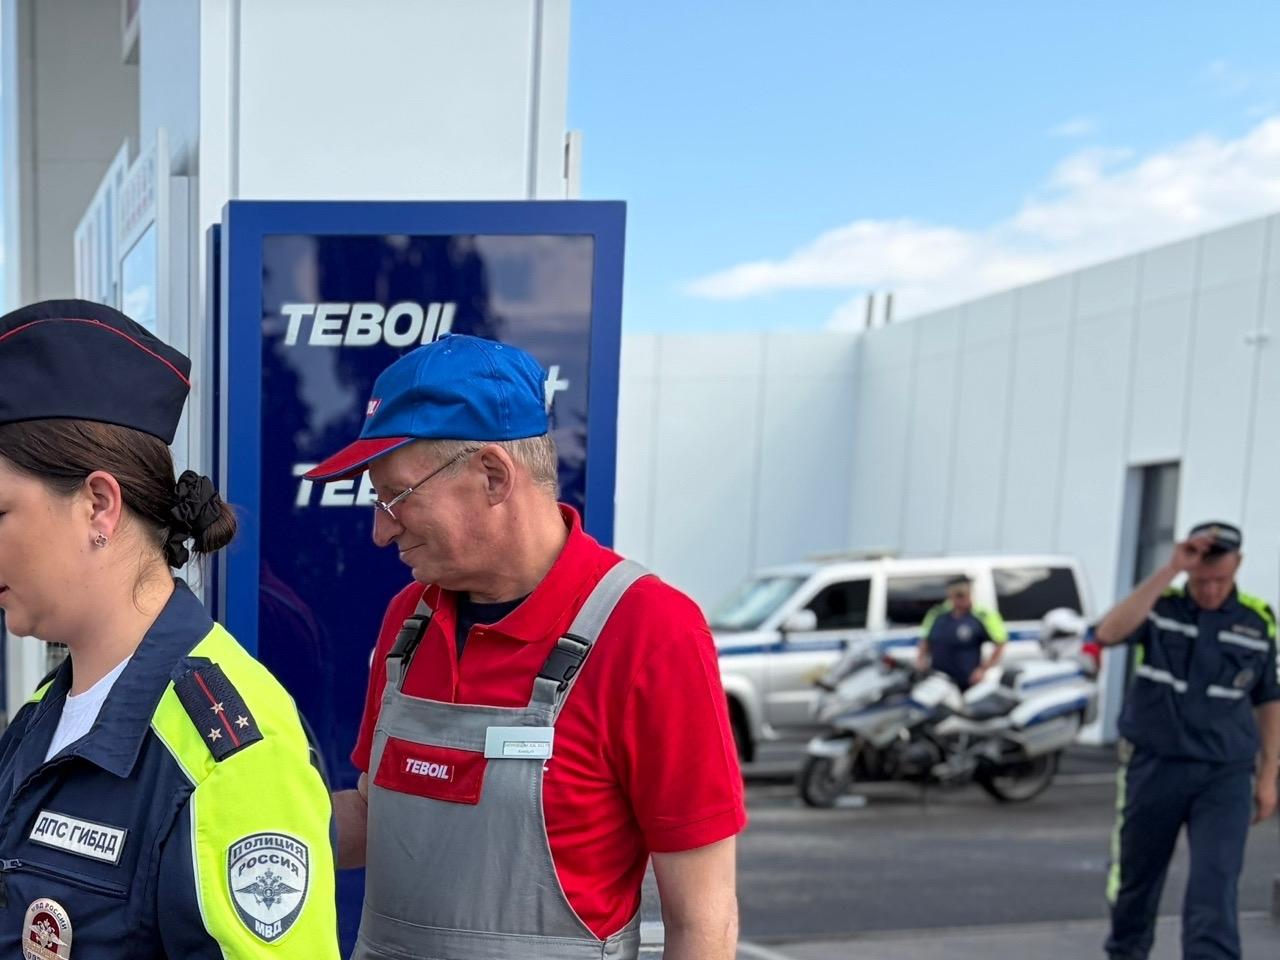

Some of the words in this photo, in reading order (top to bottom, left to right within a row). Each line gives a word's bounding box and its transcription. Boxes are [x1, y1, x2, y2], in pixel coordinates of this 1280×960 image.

[405, 758, 449, 779] TEBOIL
[34, 816, 69, 839] ДПС
[69, 825, 119, 855] ГИБДД
[233, 837, 304, 859] ПОЛИЦИЯ
[238, 854, 299, 877] РОССИЯ
[254, 920, 283, 939] МВД
